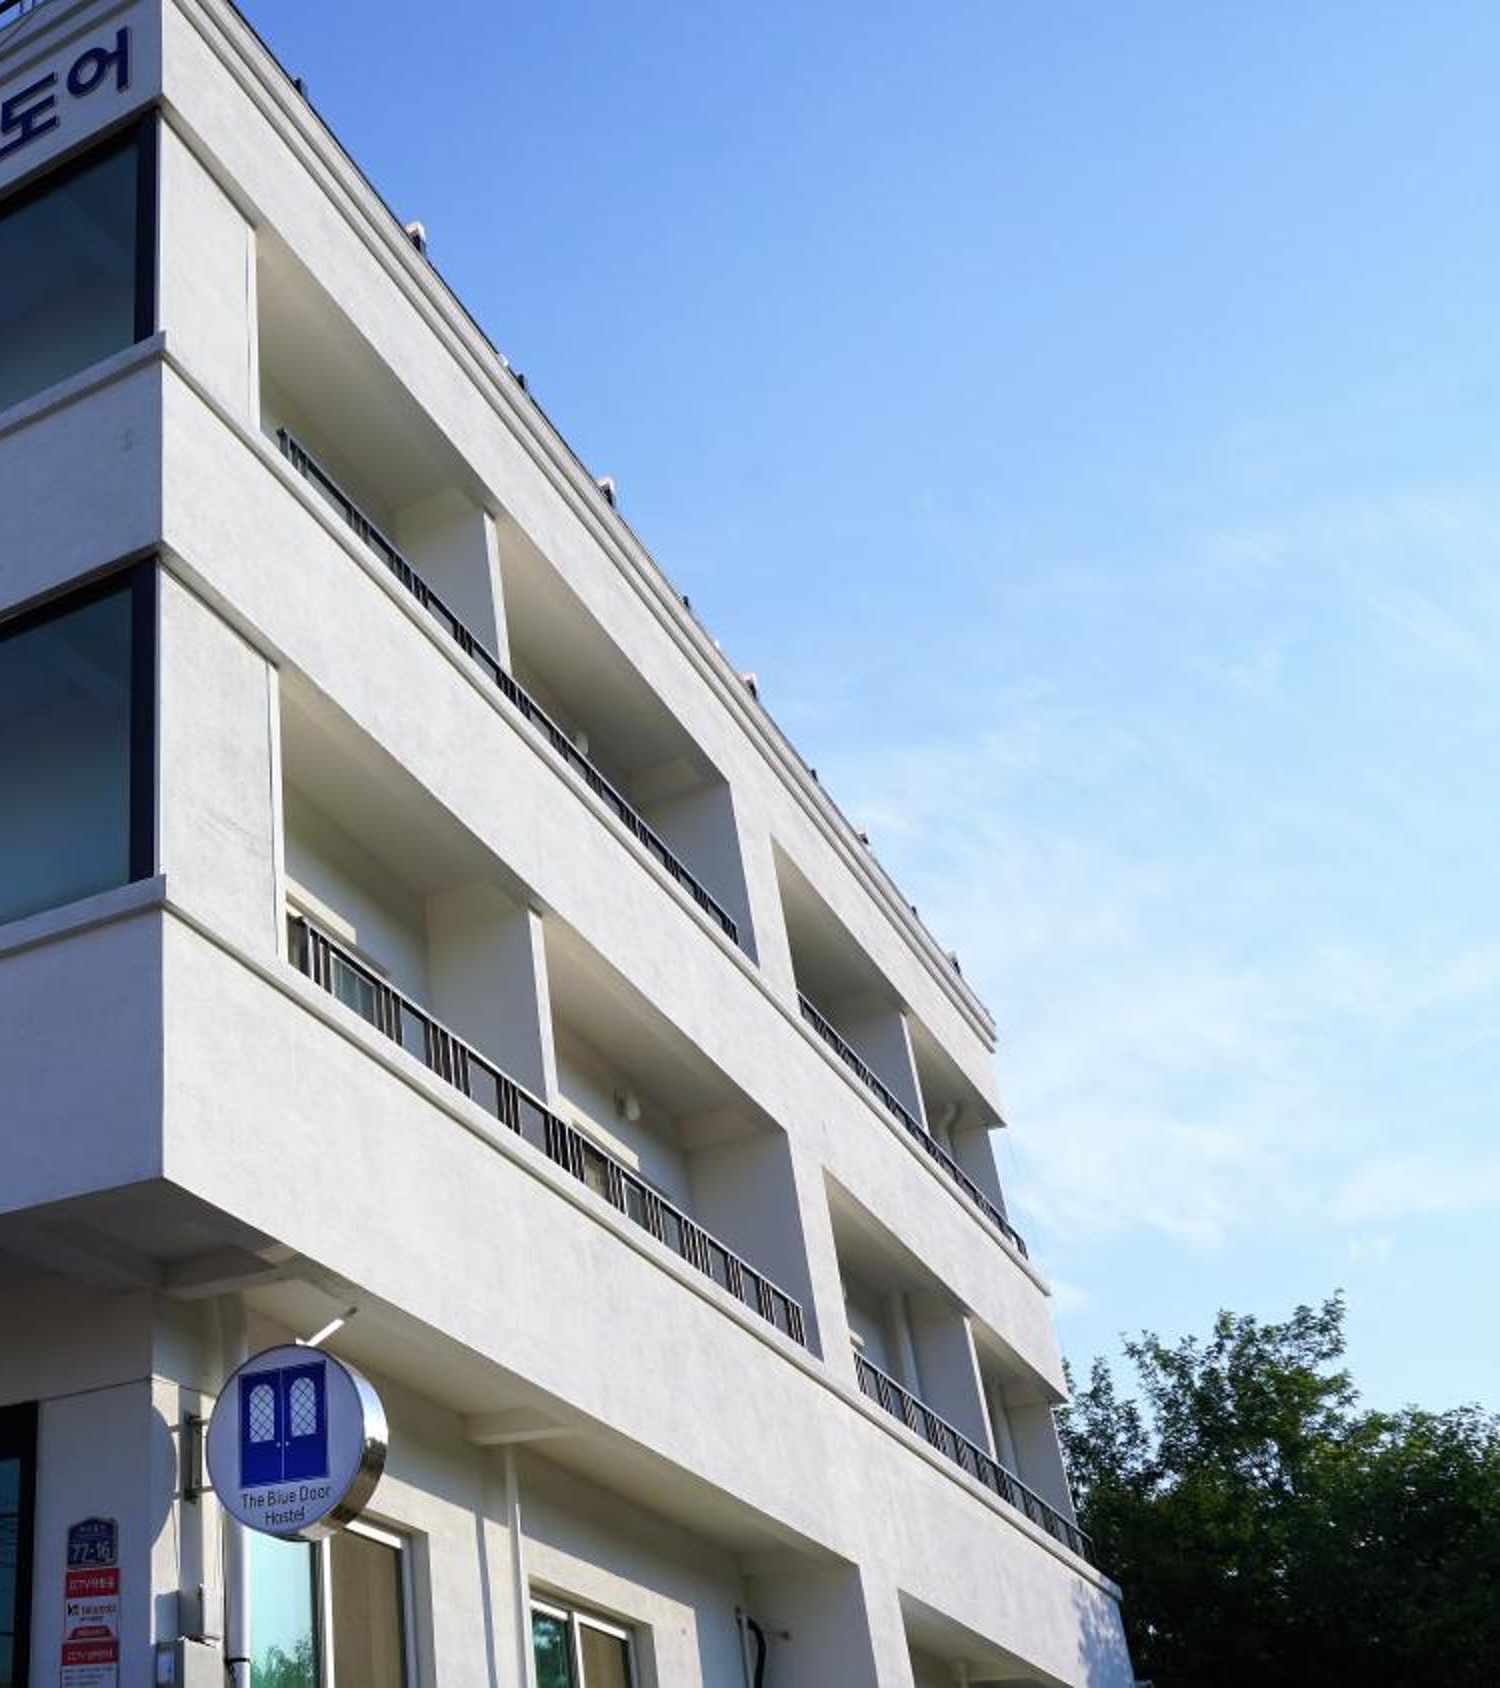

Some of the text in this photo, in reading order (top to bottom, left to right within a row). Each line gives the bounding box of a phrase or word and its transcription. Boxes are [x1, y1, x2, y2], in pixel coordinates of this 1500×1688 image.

[242, 1485, 332, 1510] The Blue Door
[264, 1505, 306, 1526] Hostel
